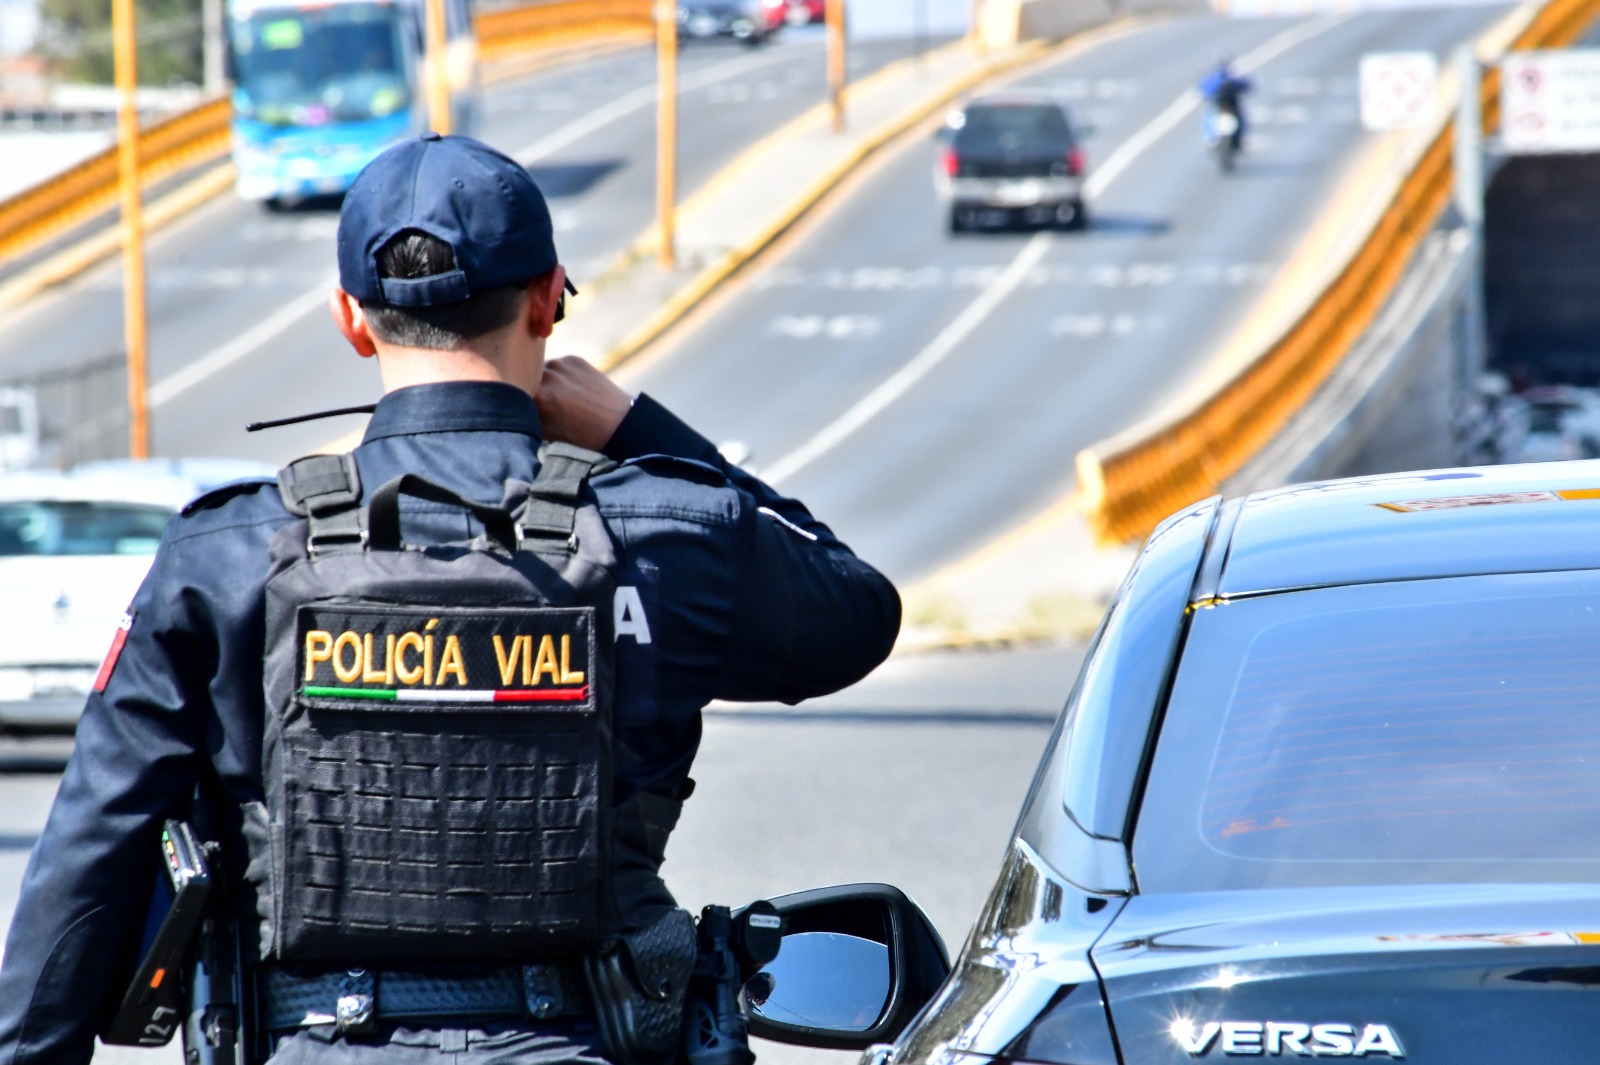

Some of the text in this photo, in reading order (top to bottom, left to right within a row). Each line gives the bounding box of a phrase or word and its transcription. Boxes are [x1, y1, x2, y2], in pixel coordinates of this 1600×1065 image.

[304, 618, 585, 686] POLICÍA VIAL
[1175, 1022, 1405, 1059] VERSA
